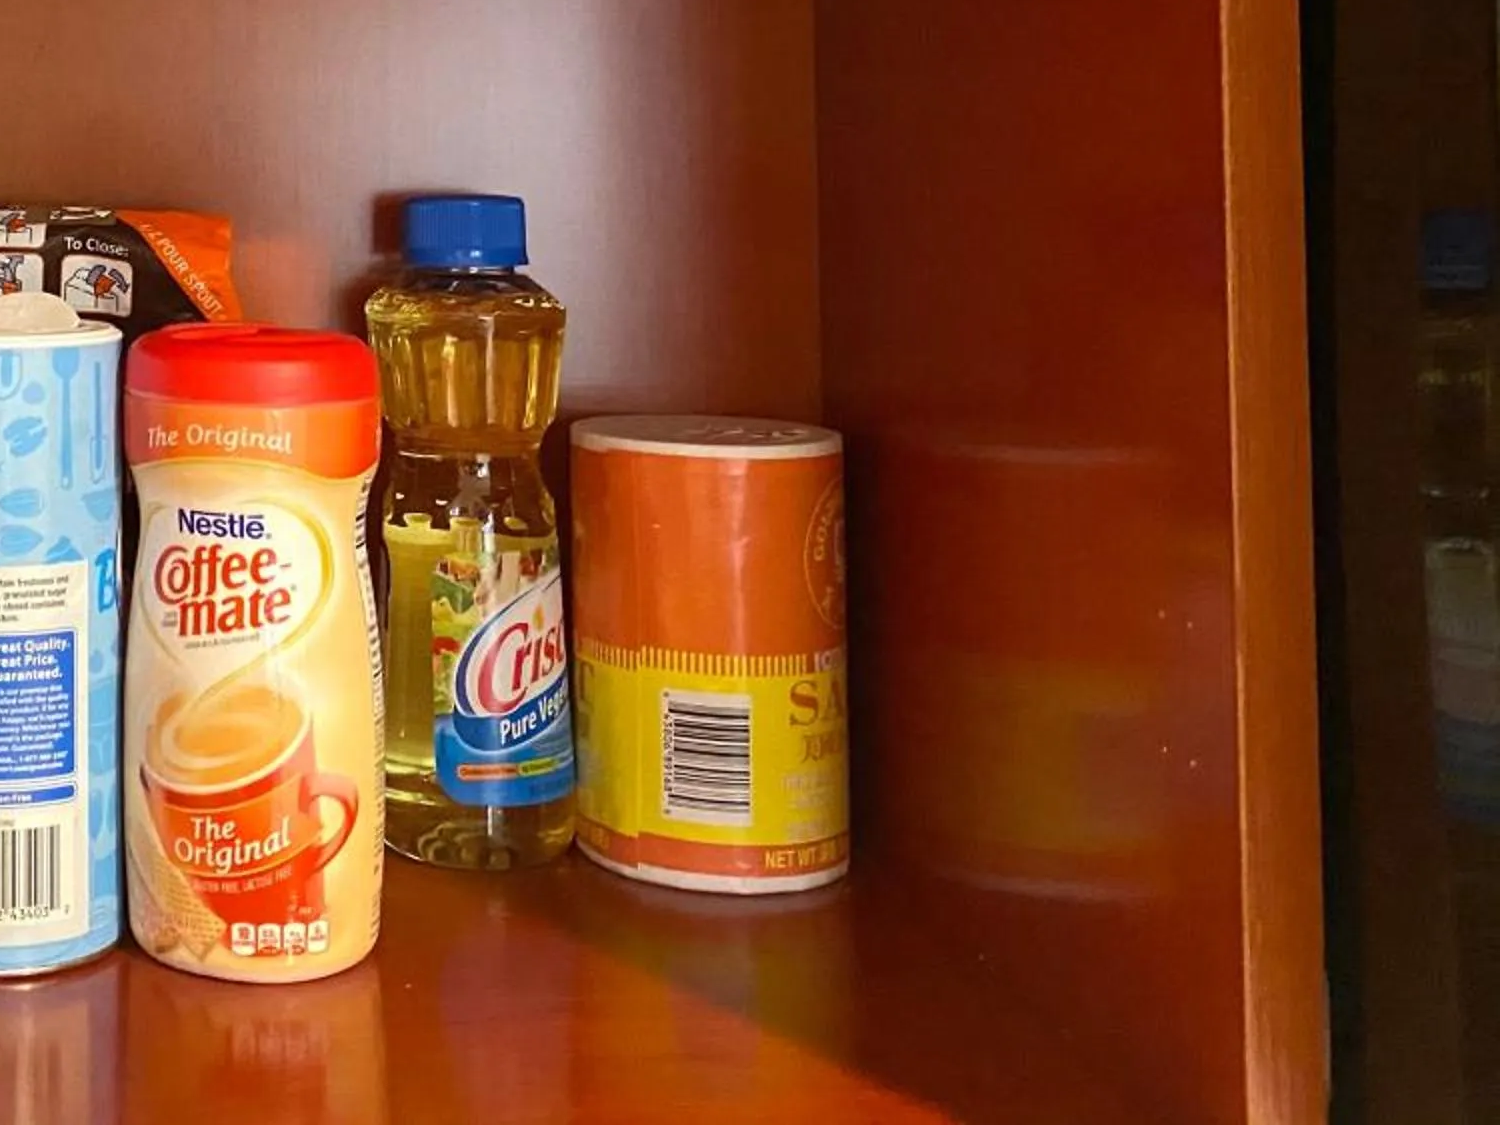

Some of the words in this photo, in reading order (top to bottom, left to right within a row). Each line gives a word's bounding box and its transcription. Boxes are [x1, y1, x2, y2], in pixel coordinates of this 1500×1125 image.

[63, 236, 83, 250] To
[156, 237, 189, 274] POUR
[148, 428, 178, 448] The
[186, 424, 293, 454] Original
[178, 586, 292, 637] mate
[24, 636, 71, 652] Quality.
[24, 653, 58, 666] Price.
[500, 711, 537, 747] Pure
[191, 816, 235, 840] The
[174, 817, 291, 875] Original
[765, 851, 797, 869] NET
